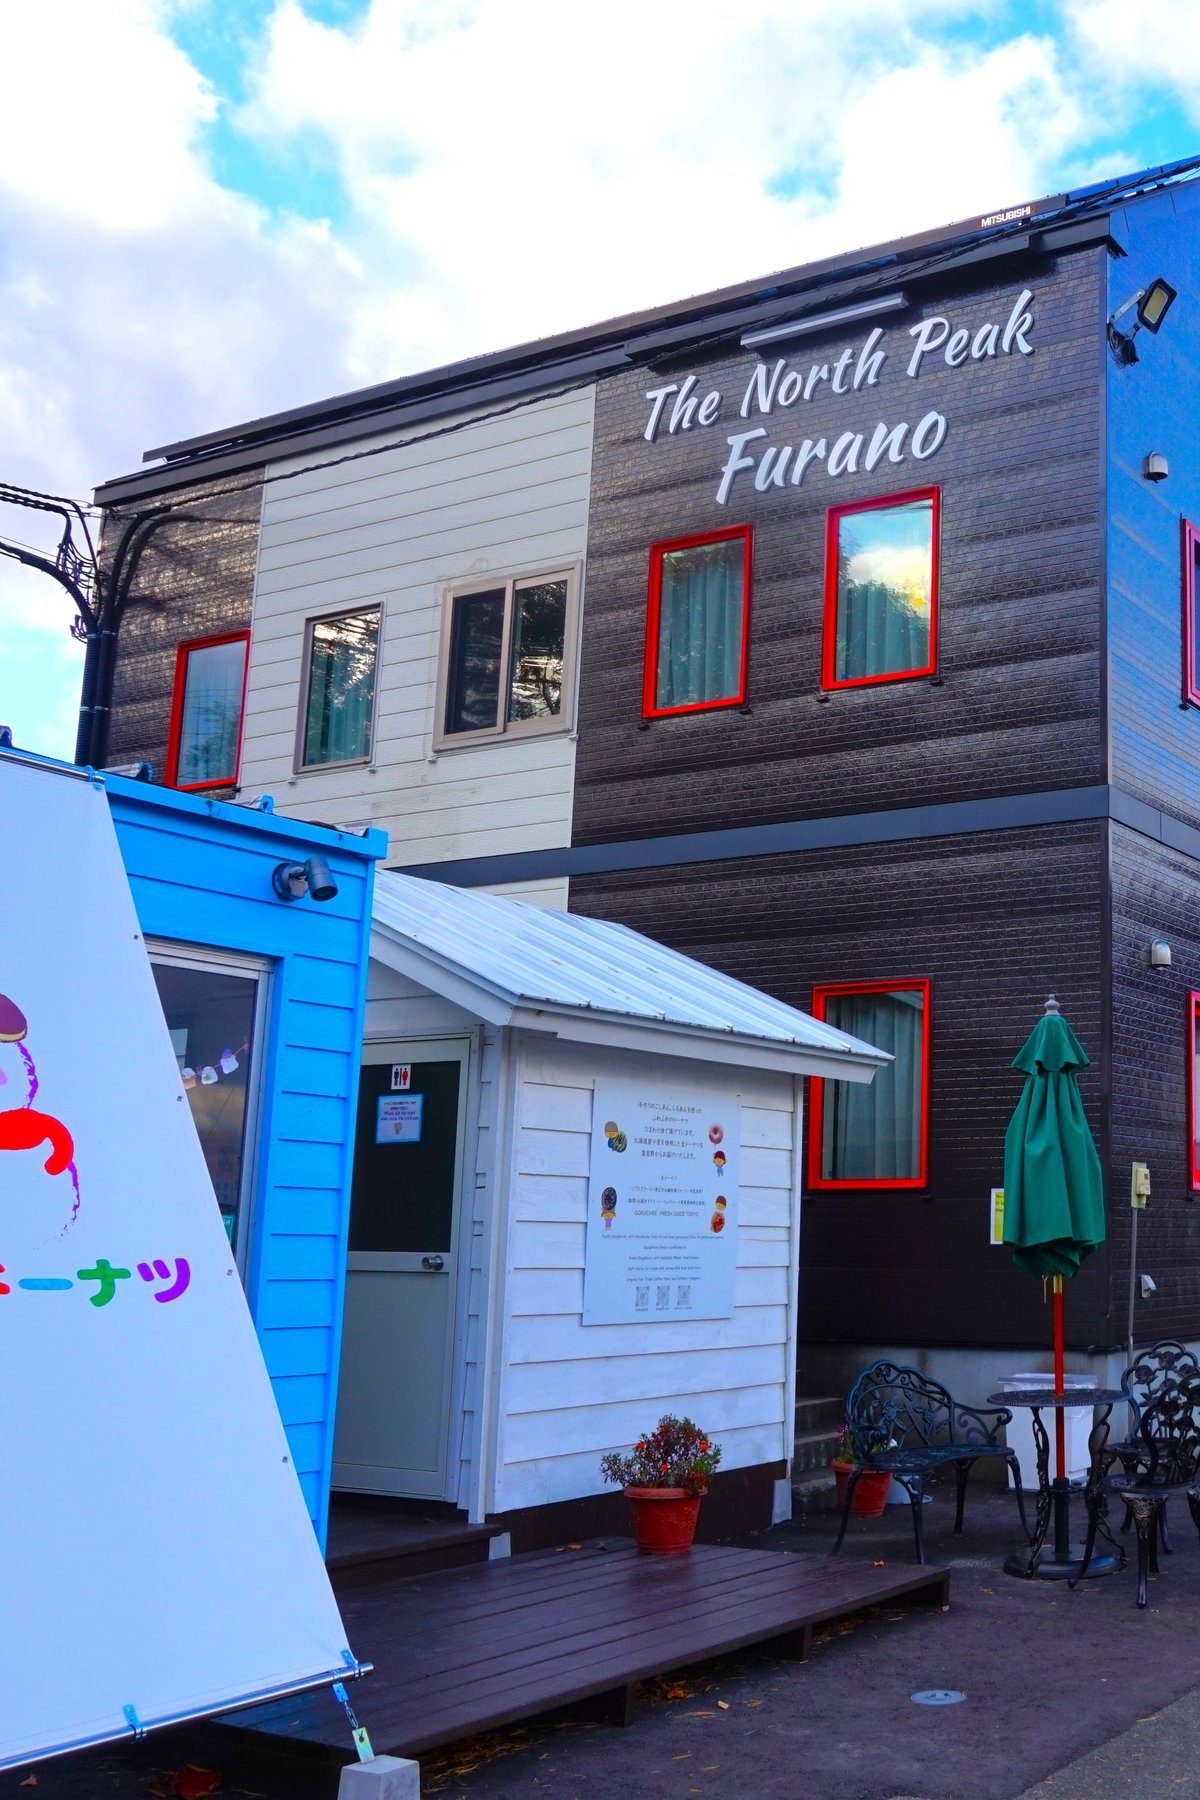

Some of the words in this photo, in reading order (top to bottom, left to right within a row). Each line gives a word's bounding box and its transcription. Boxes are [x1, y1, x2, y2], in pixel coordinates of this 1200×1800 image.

[981, 205, 1031, 228] MITSUBISHI
[643, 375, 723, 443] The
[739, 327, 887, 419] North
[905, 288, 1037, 379] Peak
[714, 410, 949, 506] Furano
[0, 1258, 191, 1308] ーナツ
